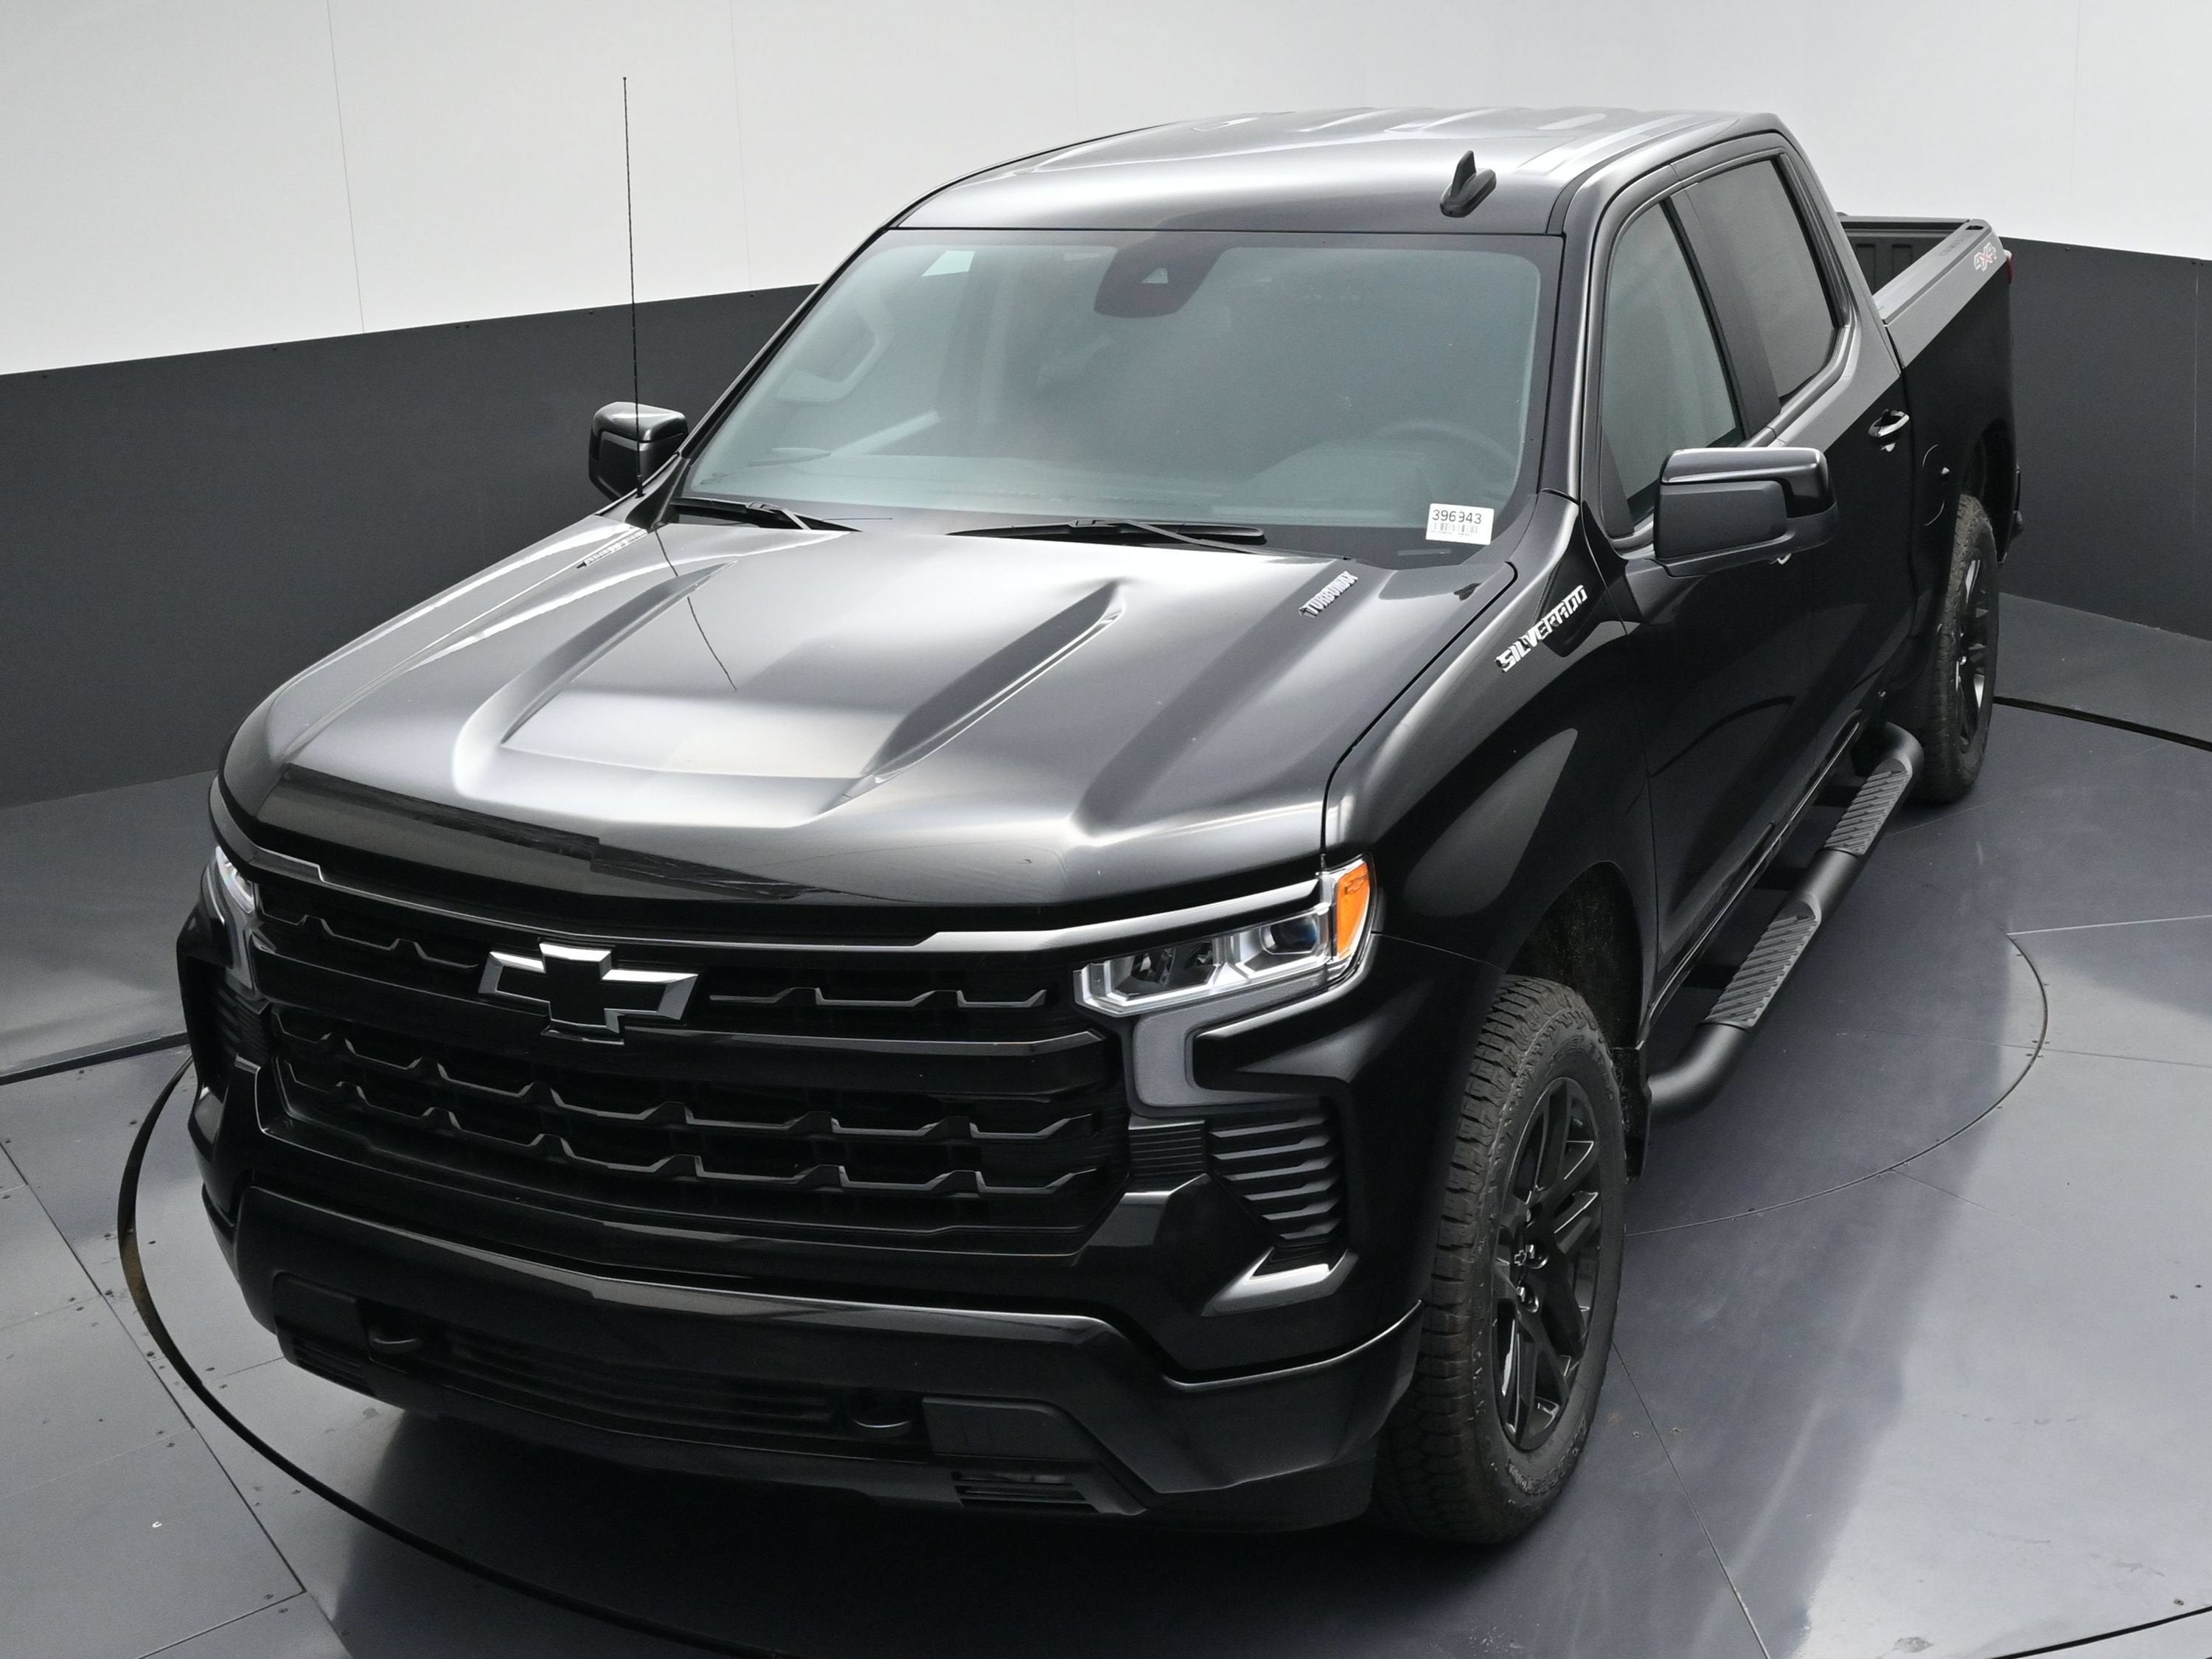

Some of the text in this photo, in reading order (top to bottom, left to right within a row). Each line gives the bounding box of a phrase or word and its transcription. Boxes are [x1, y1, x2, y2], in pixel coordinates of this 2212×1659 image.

[1431, 509, 1482, 525] 396943
[1298, 570, 1358, 616] TURBOMAX
[1495, 584, 1588, 672] SILVERADO
